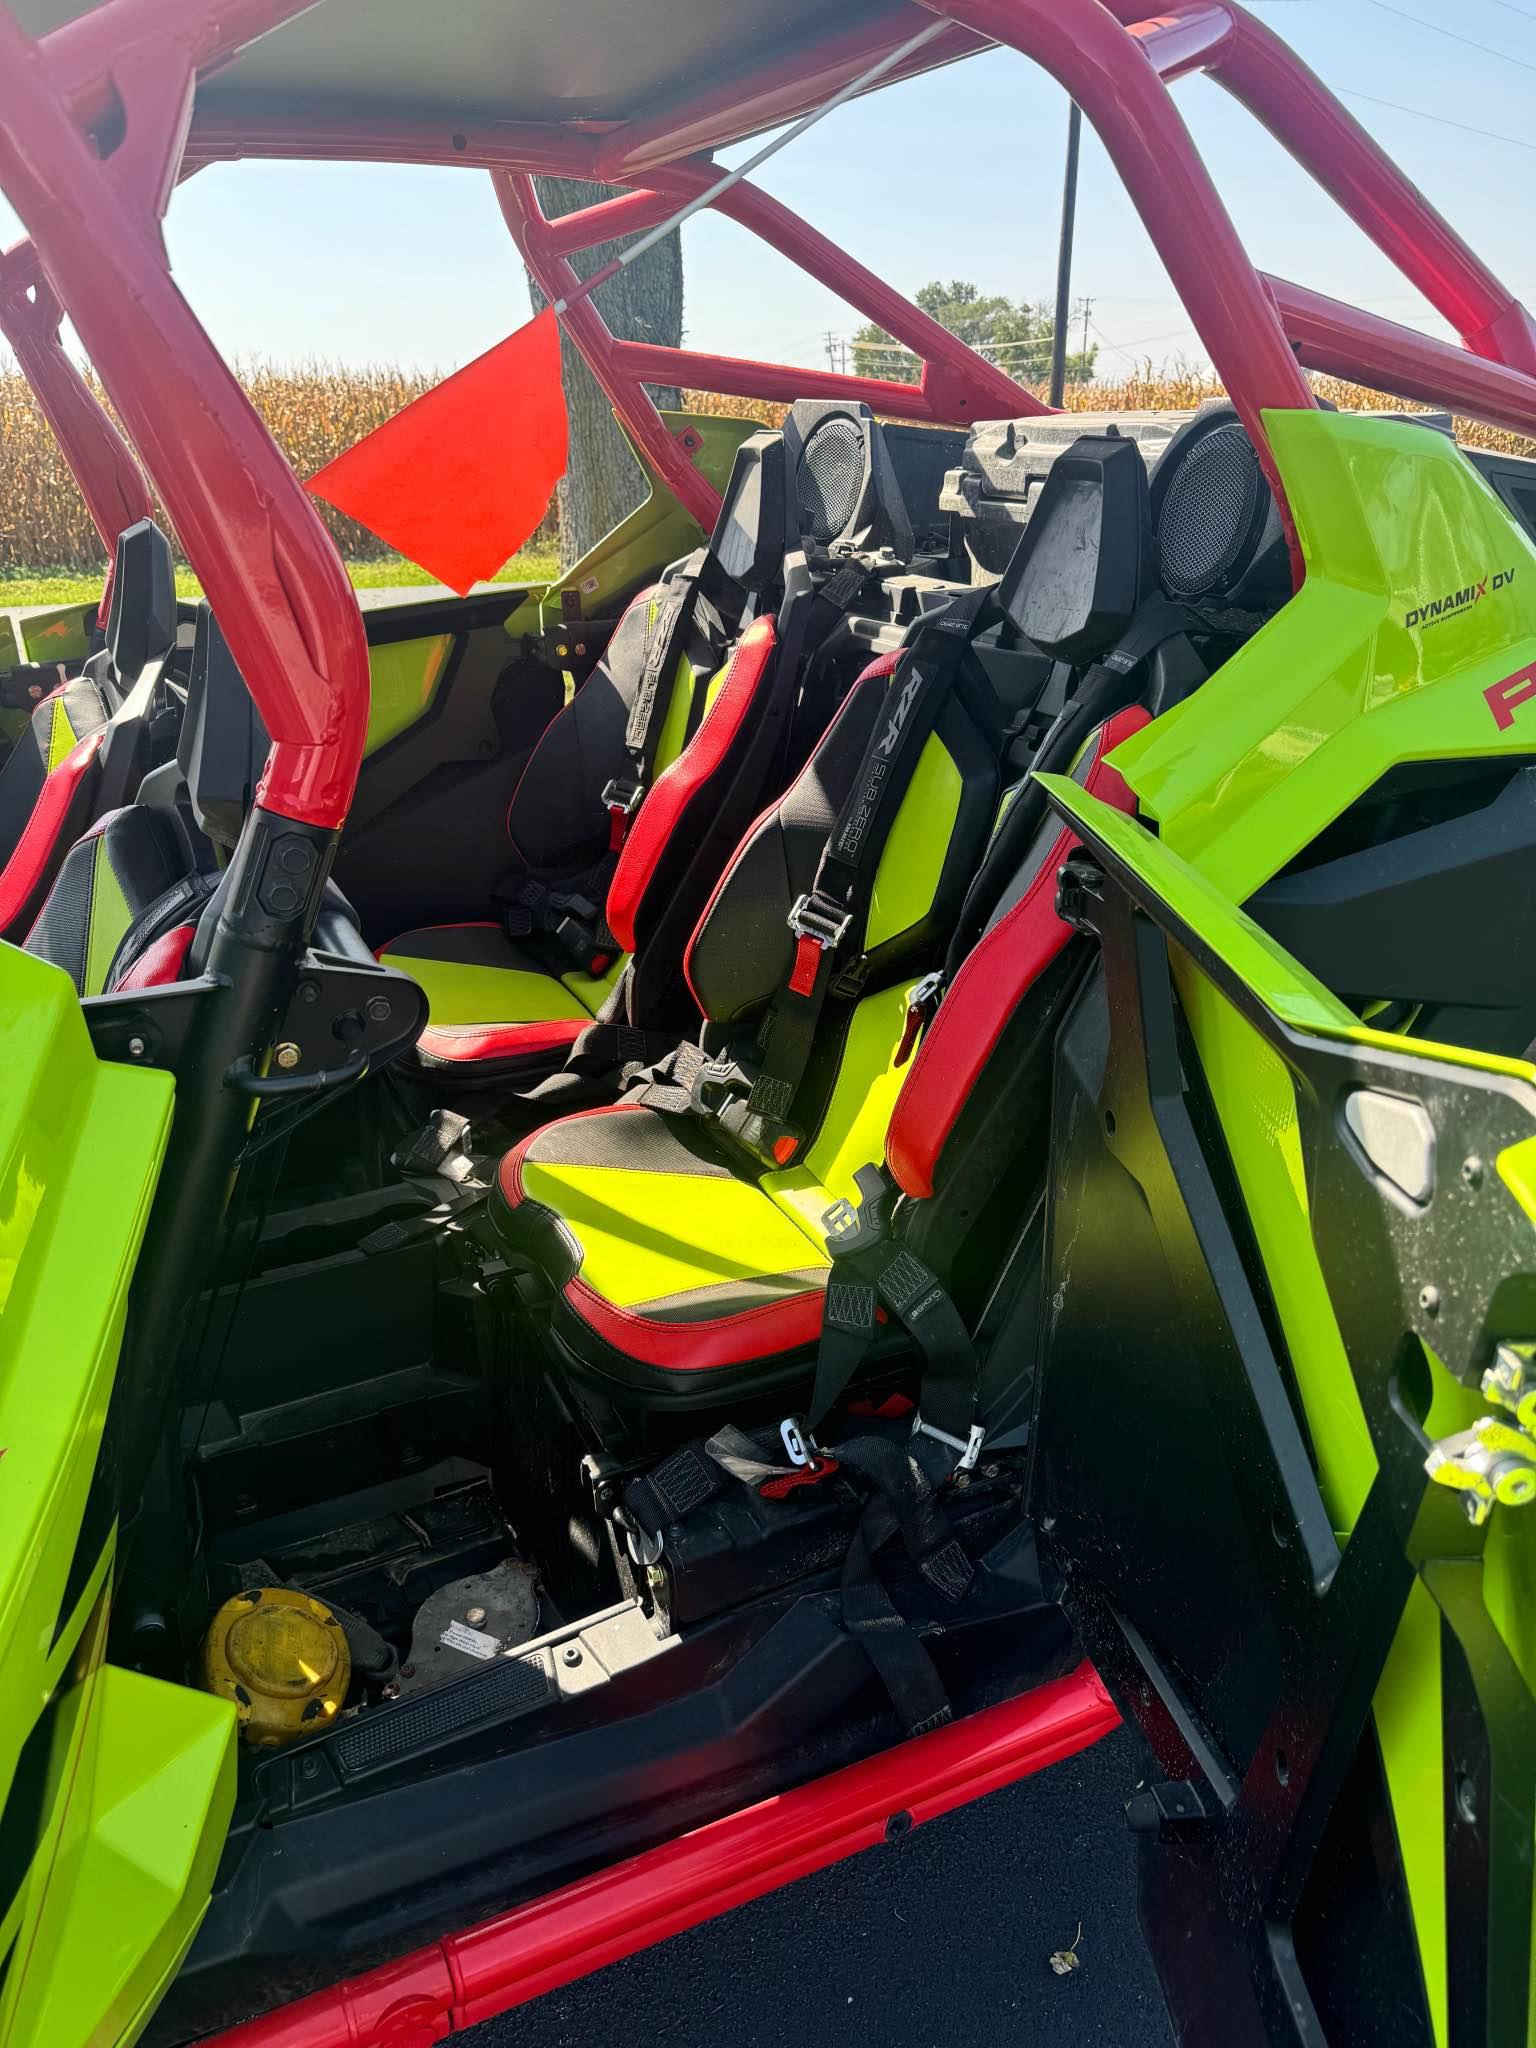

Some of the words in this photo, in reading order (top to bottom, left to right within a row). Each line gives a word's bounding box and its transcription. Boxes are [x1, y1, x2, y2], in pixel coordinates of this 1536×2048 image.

[1406, 575, 1488, 628] DYNAMIX
[1492, 568, 1515, 591] DV
[878, 666, 923, 755] RZR
[866, 763, 886, 801] SUB
[847, 804, 871, 853] ZERO
